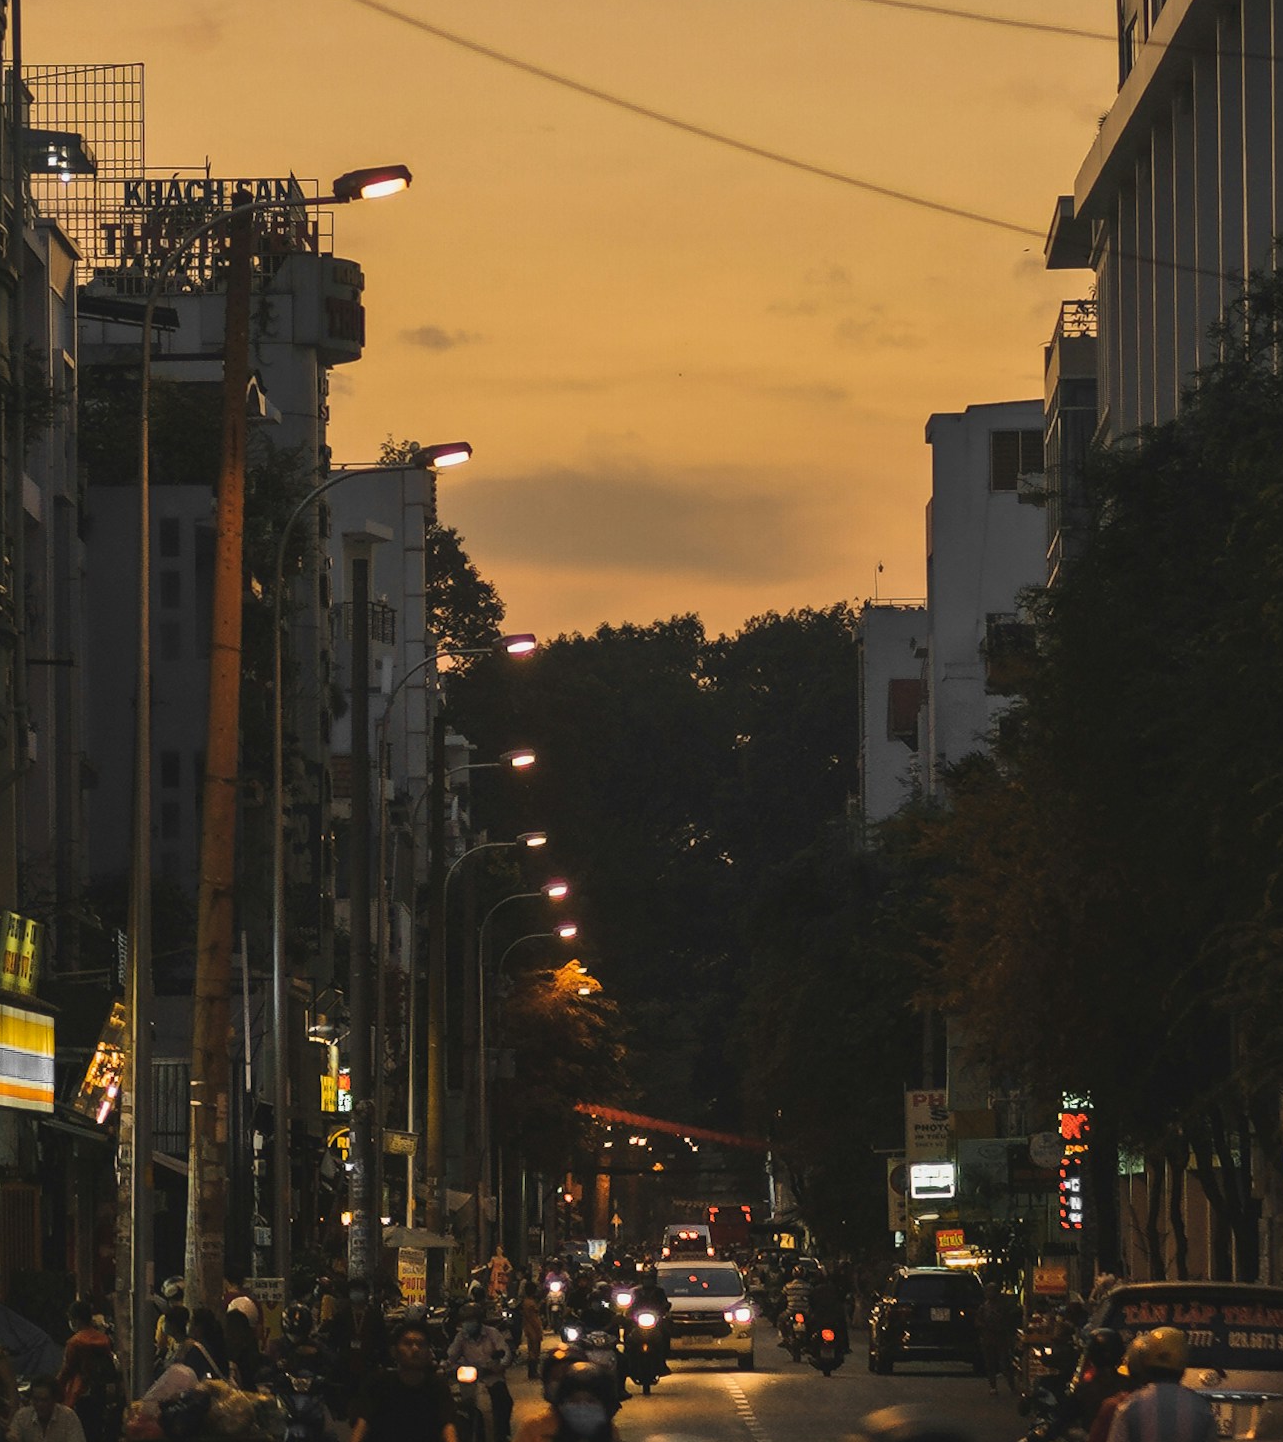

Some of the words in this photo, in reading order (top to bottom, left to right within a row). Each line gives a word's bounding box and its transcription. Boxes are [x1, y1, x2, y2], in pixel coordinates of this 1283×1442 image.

[125, 172, 223, 206] KHÁCH
[1122, 1299, 1169, 1324] TÂN
[1173, 1300, 1217, 1329] LẬP
